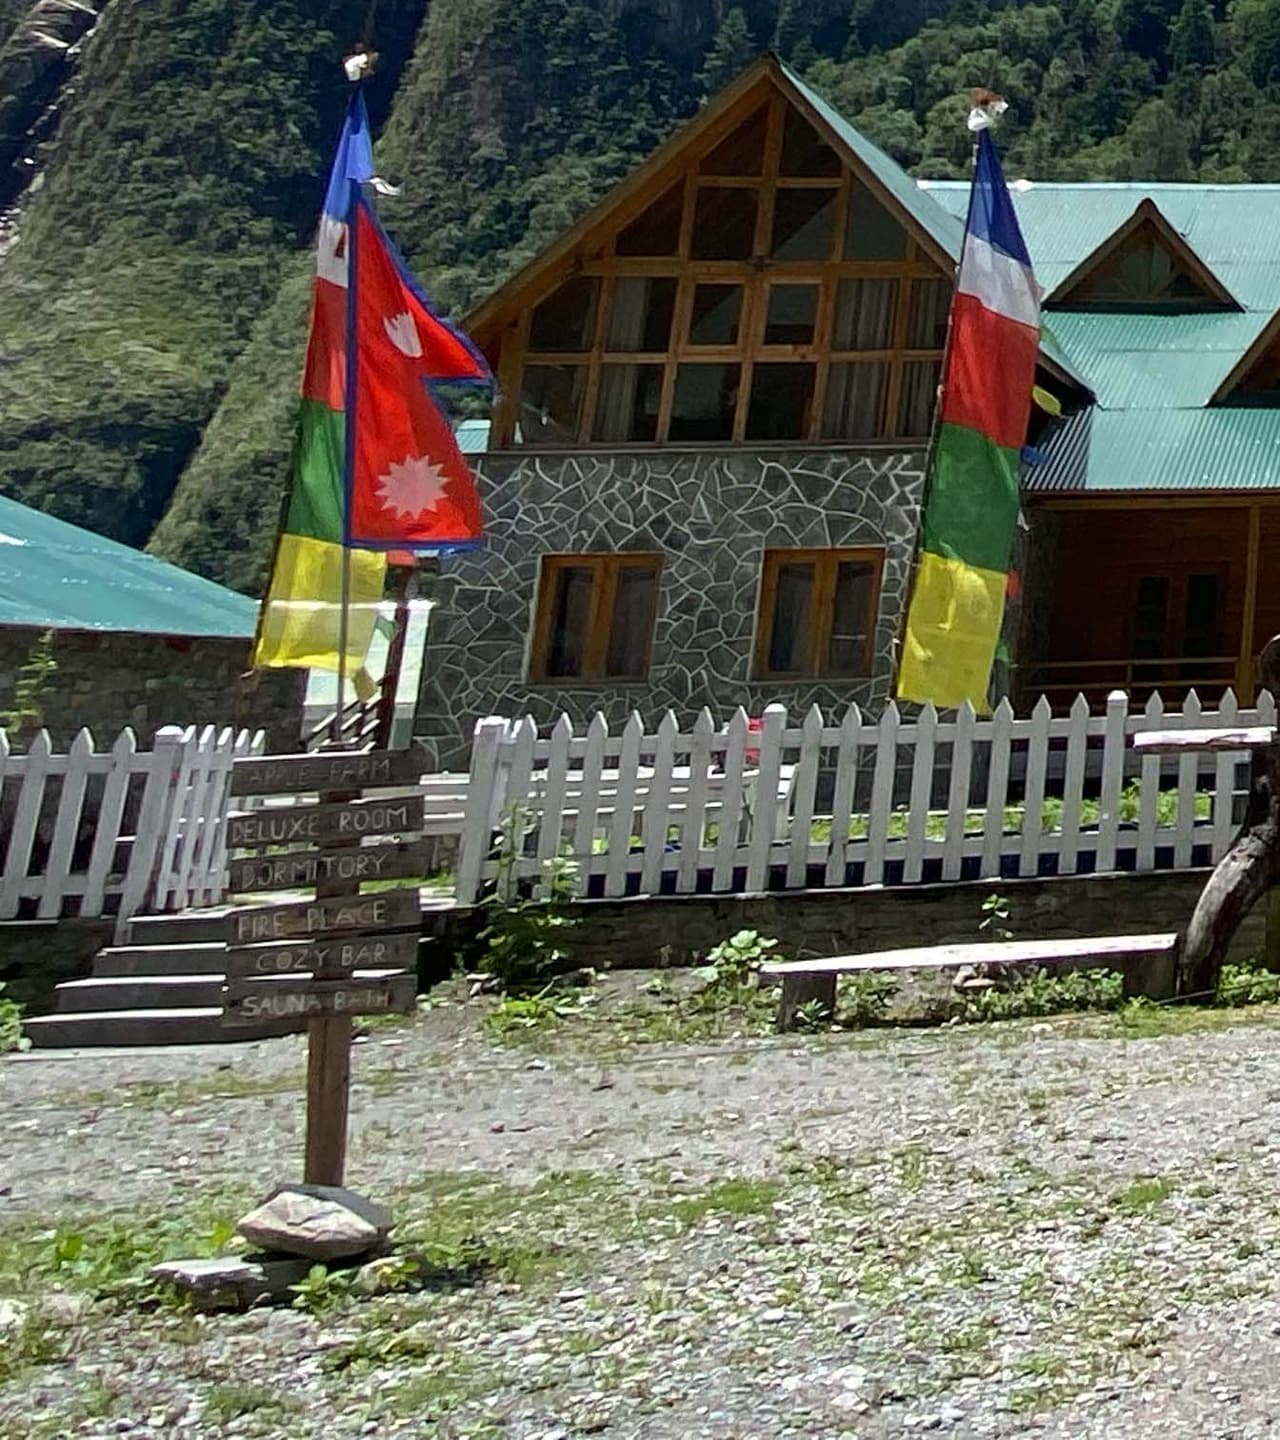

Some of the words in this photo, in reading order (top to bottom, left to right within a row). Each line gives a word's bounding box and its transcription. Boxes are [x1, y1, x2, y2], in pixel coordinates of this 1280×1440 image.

[329, 759, 390, 782] FARM
[232, 814, 319, 842] DELUXE
[339, 807, 408, 832] ROOM
[242, 854, 386, 889] DORMITORY
[237, 911, 286, 940] FIRE
[307, 900, 386, 932] PLACE
[255, 947, 330, 972] COZY
[340, 943, 386, 967] BAR
[239, 991, 322, 1017] SAUNA
